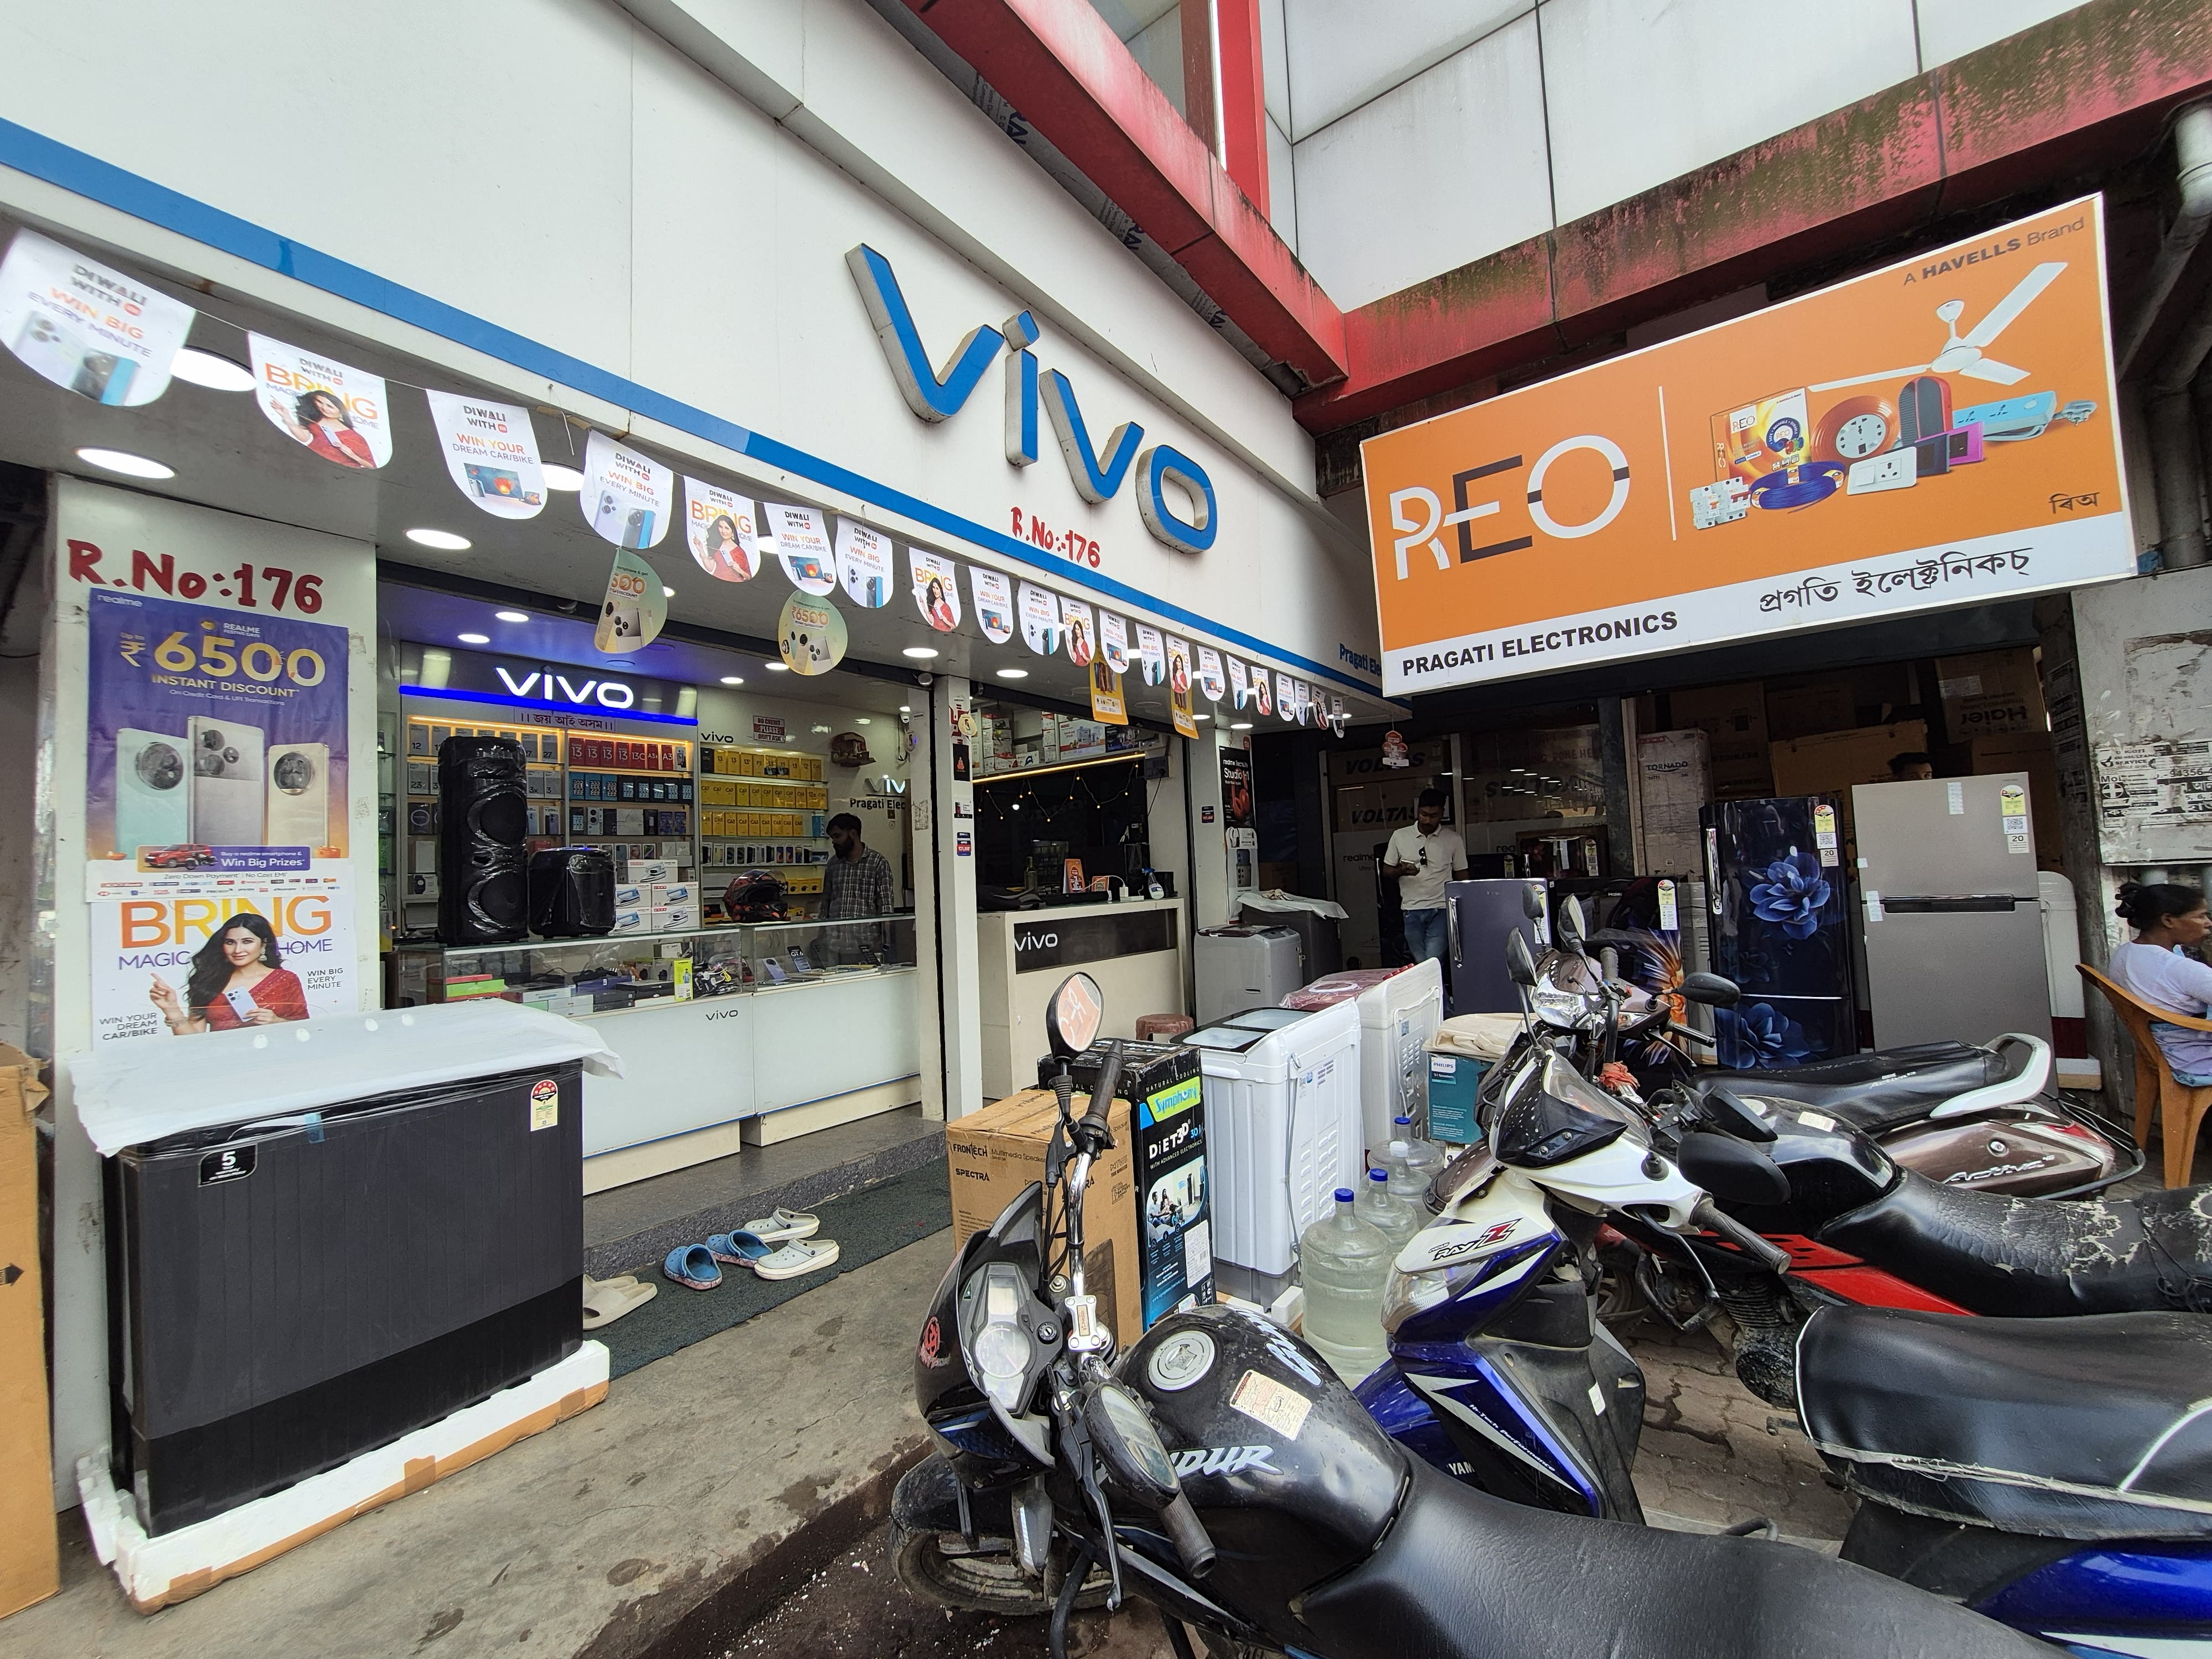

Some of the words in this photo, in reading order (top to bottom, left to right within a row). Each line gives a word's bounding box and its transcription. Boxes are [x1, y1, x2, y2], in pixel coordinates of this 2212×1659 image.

[1903, 273, 1917, 286] A
[1923, 238, 2021, 279] HAVELLS
[2027, 217, 2084, 246] Brand
[70, 276, 122, 307] WITH
[71, 264, 147, 306] DIWALI
[49, 287, 98, 320] WIN
[105, 313, 145, 340] BIG
[27, 291, 86, 325] EVERY
[88, 321, 152, 358] MINUTE
[300, 358, 343, 378] DIWALI
[301, 367, 331, 382] WITH
[845, 243, 1217, 553] vivo
[463, 405, 506, 422] DIWALI
[467, 418, 496, 431] WITH
[1733, 415, 1756, 431] REO
[456, 433, 485, 448] WIN
[488, 439, 525, 455] YOUR
[452, 443, 488, 457] DREAM
[491, 451, 534, 465] CAR/BIKE
[615, 452, 651, 473] DIWALI
[615, 461, 640, 477] WITH
[607, 470, 632, 486] WIN
[634, 479, 654, 495] BIG
[600, 477, 628, 492] EVERY
[629, 488, 660, 507] MINUTE
[709, 489, 732, 502] DIWALI
[710, 497, 727, 506] WITH
[1390, 435, 1630, 581] REO
[785, 512, 810, 521] DIWALI
[787, 520, 804, 529] WITH
[781, 533, 799, 543] WIN
[801, 535, 821, 545] YOUR
[854, 528, 878, 542] DIWALI
[854, 536, 871, 547] WITH
[780, 541, 801, 550] DREAM
[801, 544, 827, 552] CAR/BIKE
[850, 546, 865, 557] WIN
[867, 551, 880, 563] BIG
[926, 557, 940, 566] DIWALI
[845, 554, 863, 565] EVERY
[864, 561, 885, 572] MINUTE
[983, 573, 999, 582] DIWALI
[97, 594, 142, 608] realme
[980, 589, 990, 598] WIN
[990, 593, 1005, 602] YOUR
[1030, 590, 1047, 599] DIWALI
[1028, 606, 1039, 615] WIN
[1040, 608, 1050, 617] BIG
[223, 623, 260, 634] REALME
[1402, 644, 1494, 676] PRAGATI
[1502, 611, 1678, 658] ELECTRONICS
[1339, 643, 1368, 671] Pragati
[152, 674, 216, 691] INSTANT
[495, 666, 634, 709] vivo
[701, 731, 734, 743] vivo
[572, 747, 582, 757] 13
[588, 748, 597, 758] 13
[603, 749, 612, 759] 13
[618, 750, 628, 760] 13
[1646, 761, 1688, 771] TORNADO
[1224, 767, 1243, 780] Studio
[864, 774, 905, 794] viv
[850, 797, 885, 810] Pragati
[2011, 834, 2024, 843] 20
[221, 858, 246, 867] Win
[248, 858, 267, 869] Big
[120, 895, 332, 949] BRING
[1014, 931, 1058, 952] vivo
[118, 951, 191, 971] MAGIC
[275, 938, 334, 956] HOME
[307, 969, 326, 978] WIN
[307, 975, 336, 985] EVERY
[307, 981, 341, 991] MINUTE
[99, 1015, 123, 1025] WIN
[126, 1012, 158, 1022] YOUR
[705, 1008, 739, 1021] vivo
[116, 1020, 158, 1031] DREAM
[102, 1027, 158, 1041] CAR/BIKE
[1146, 1078, 1173, 1093] NATURAL
[1176, 1067, 1201, 1081] COOLING
[1154, 1086, 1197, 1114] Symphony
[953, 1142, 988, 1160] FRONTECH
[991, 1148, 1022, 1160] Multimedia
[1150, 1161, 1161, 1170] WITH
[1161, 1151, 1180, 1165] ADVANCED
[1180, 1139, 1203, 1155] ELECTRONICS
[222, 1151, 236, 1166] 5
[955, 1168, 990, 1182] SPECTRA
[1469, 1404, 1499, 1428] Hi-Tech
[1499, 1429, 1556, 1472] Performance
